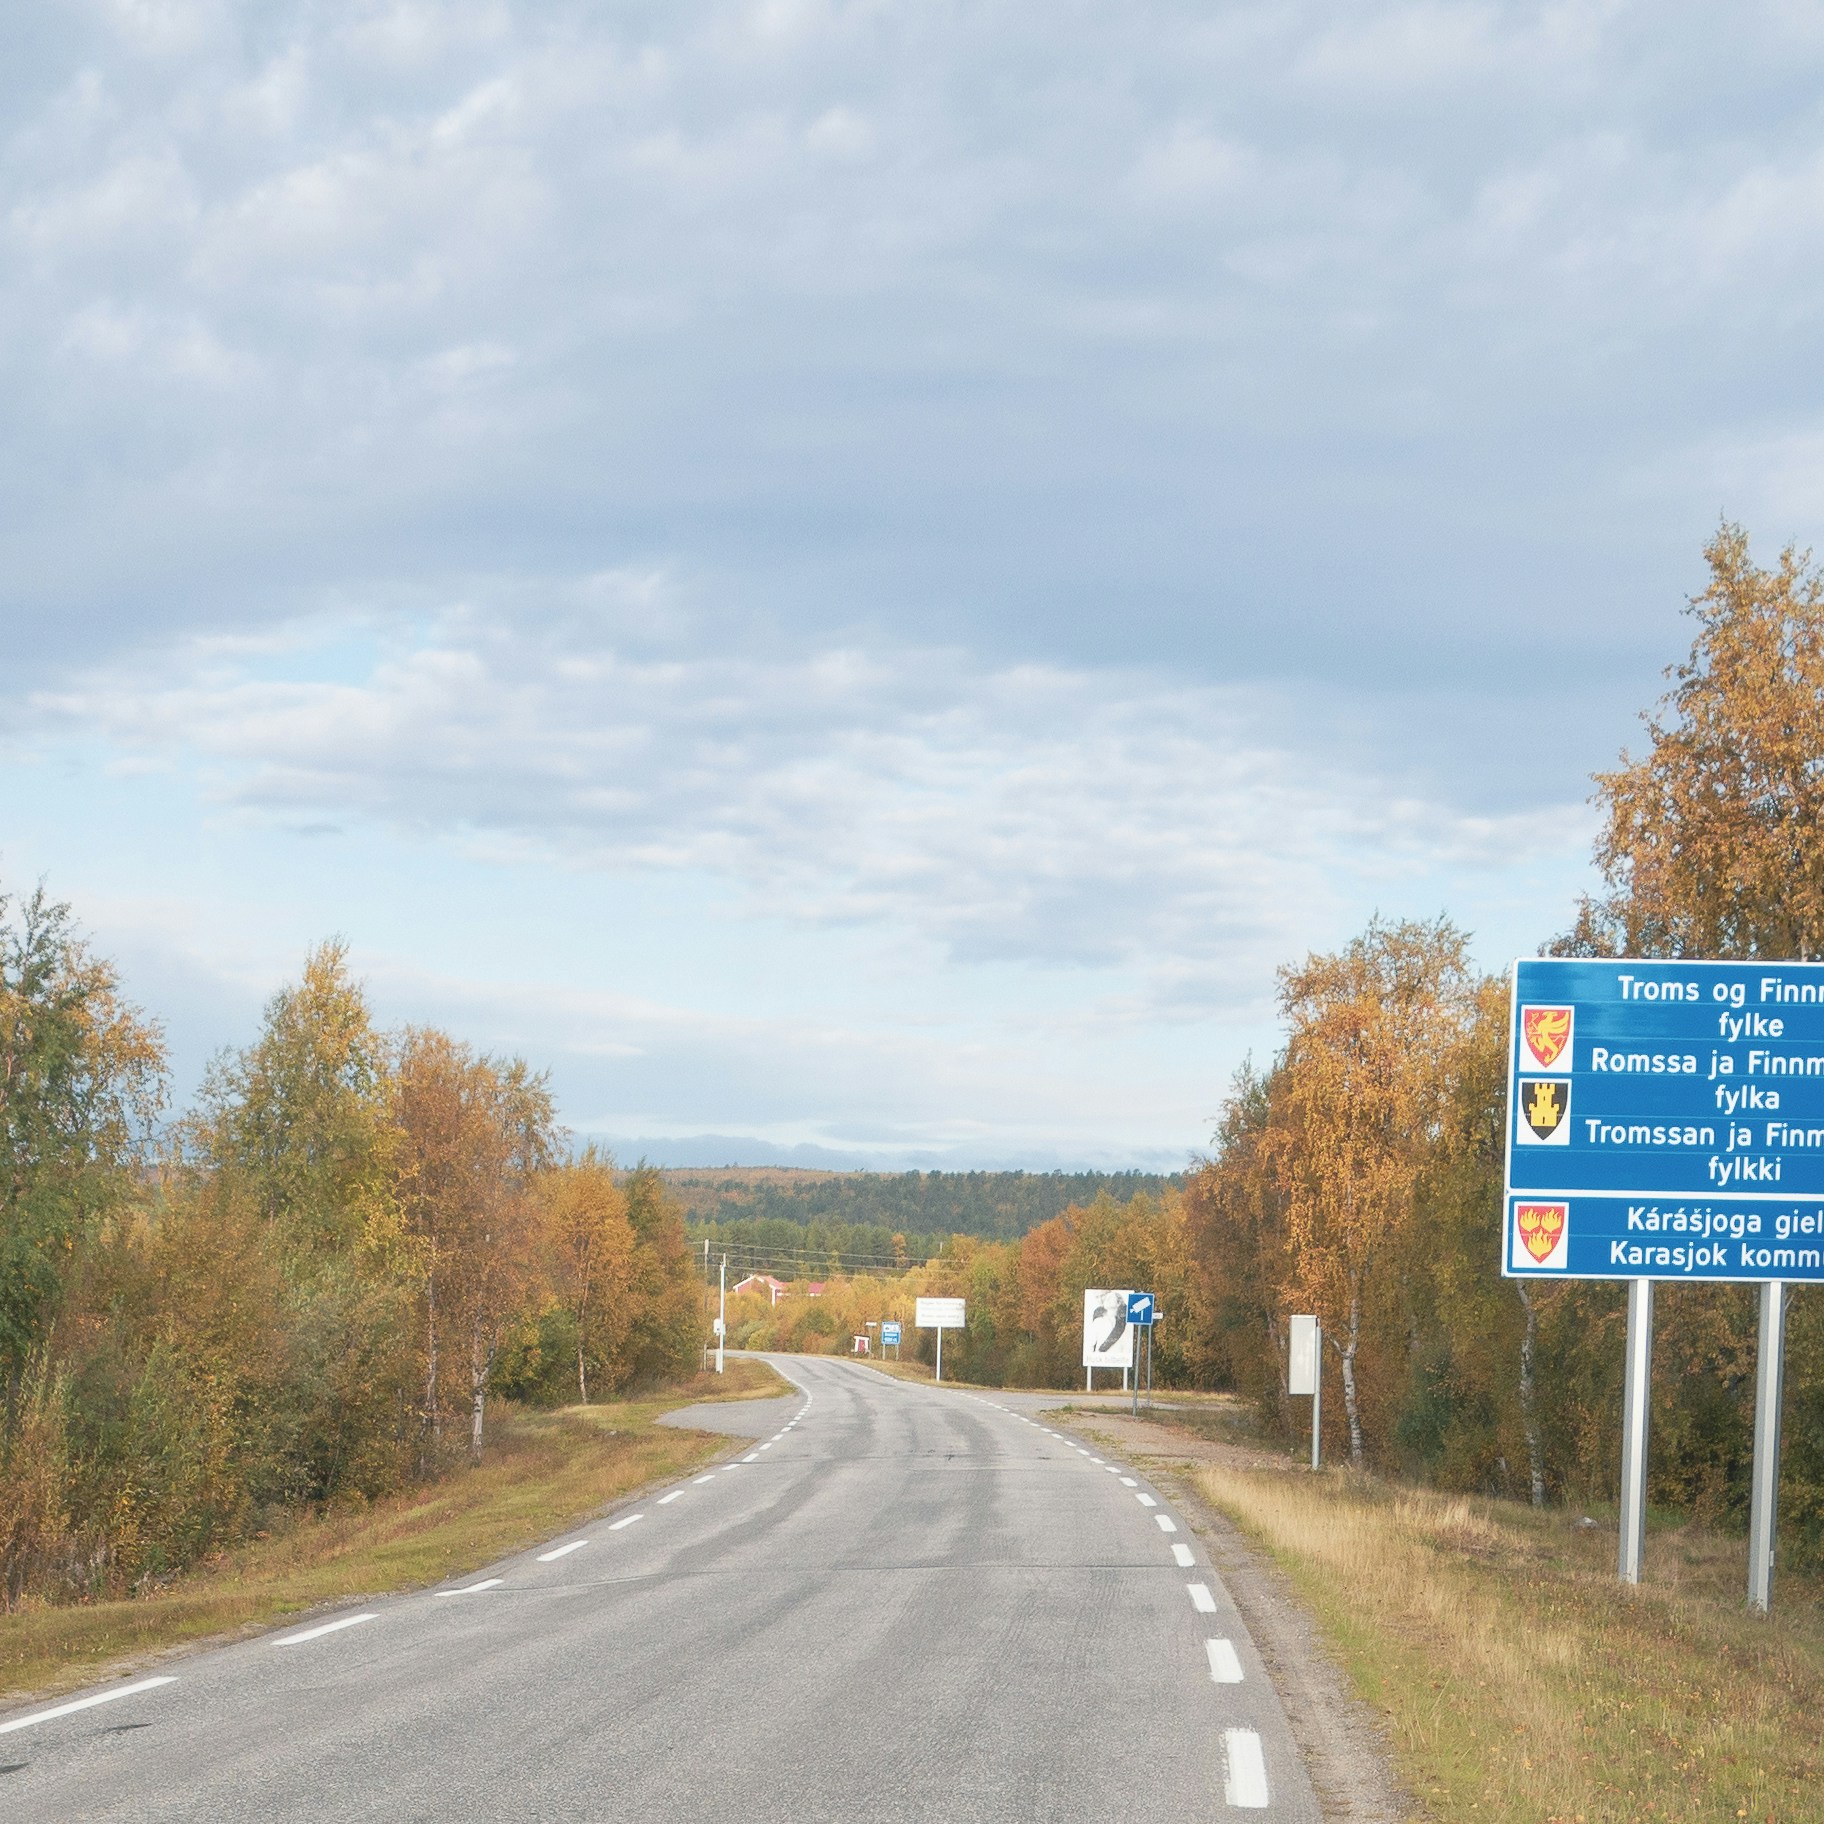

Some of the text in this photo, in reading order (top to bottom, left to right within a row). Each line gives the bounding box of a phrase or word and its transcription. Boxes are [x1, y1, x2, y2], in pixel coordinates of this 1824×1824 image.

[1617, 975, 1700, 1002] Troms
[1712, 982, 1746, 1009] og
[1718, 1011, 1784, 1043] fylke
[1591, 1047, 1697, 1074] Romssa
[1707, 1049, 1734, 1081] ja
[1714, 1084, 1780, 1115] fylka
[1585, 1119, 1715, 1146] Tromssan
[1725, 1121, 1752, 1153] ja
[1708, 1155, 1782, 1187] fylkki
[1627, 1206, 1762, 1239] Kárášjoga
[1610, 1240, 1728, 1272] Karasjok
